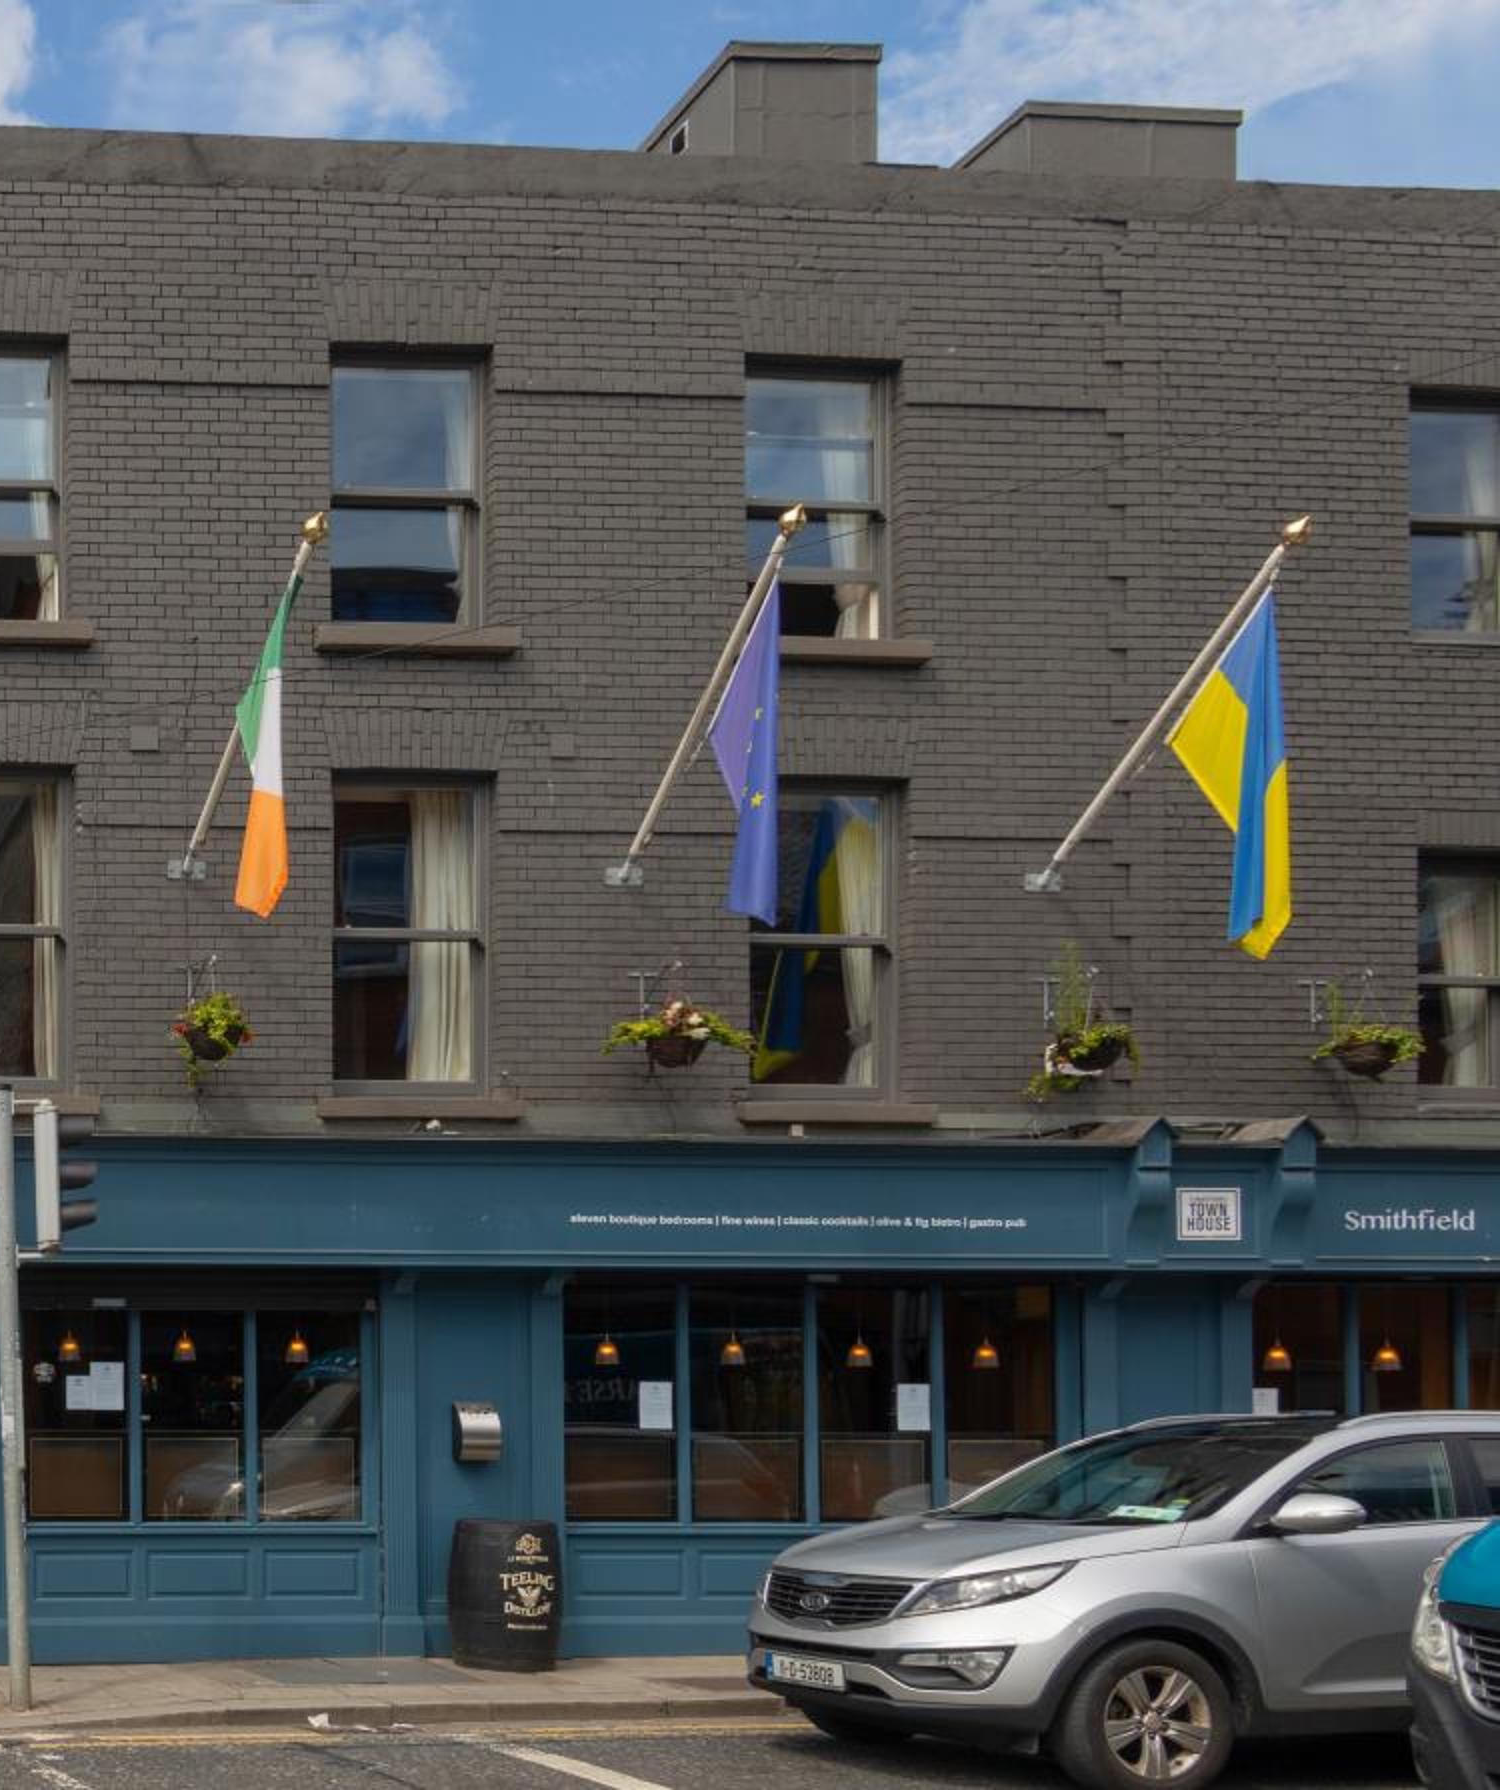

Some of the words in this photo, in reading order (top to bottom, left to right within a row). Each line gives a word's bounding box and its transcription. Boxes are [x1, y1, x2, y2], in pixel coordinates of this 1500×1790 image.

[1188, 1202, 1228, 1217] TOWN
[609, 1213, 657, 1226] boutique
[659, 1214, 714, 1225] bedrooms
[721, 1215, 742, 1225] fine
[744, 1216, 775, 1225] wines
[783, 1215, 819, 1226] classic
[821, 1215, 868, 1226] cocktails
[931, 1216, 962, 1227] bistro
[969, 1217, 1003, 1229] gastro
[1187, 1217, 1231, 1231] HOUSE
[1344, 1207, 1475, 1231] Smithfield
[500, 1571, 556, 1591] TEELING
